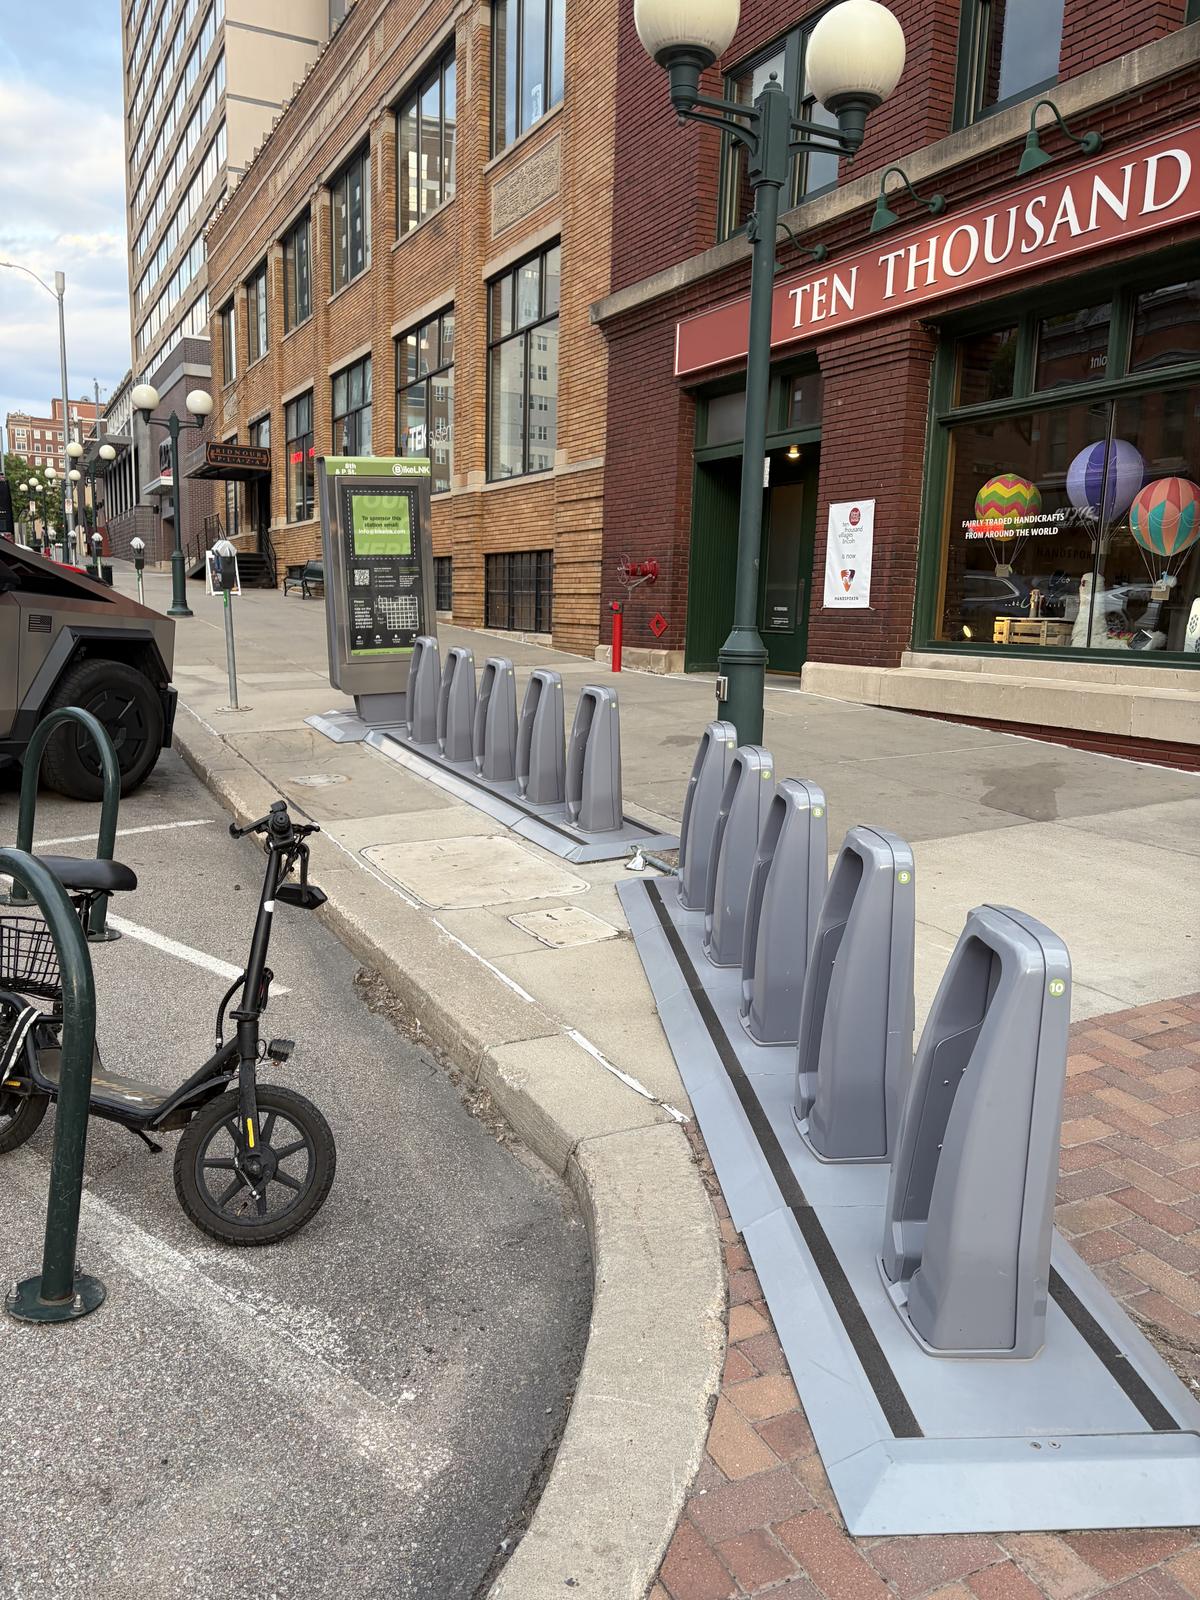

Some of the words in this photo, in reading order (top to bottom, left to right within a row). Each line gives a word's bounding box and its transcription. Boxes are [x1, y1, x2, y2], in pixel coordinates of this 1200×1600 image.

[788, 265, 860, 328] TEN
[878, 148, 1193, 300] THOUSAND
[215, 448, 262, 457] RIDNOUR
[392, 463, 430, 476] BikeLNK
[1014, 513, 1065, 524] HANDICRAFTS
[965, 531, 984, 540] FROM
[985, 529, 1014, 539] AROUND
[1016, 528, 1030, 537] THE
[1031, 527, 1059, 536] WORLD
[901, 873, 908, 881] 9
[1050, 983, 1064, 993] 10
